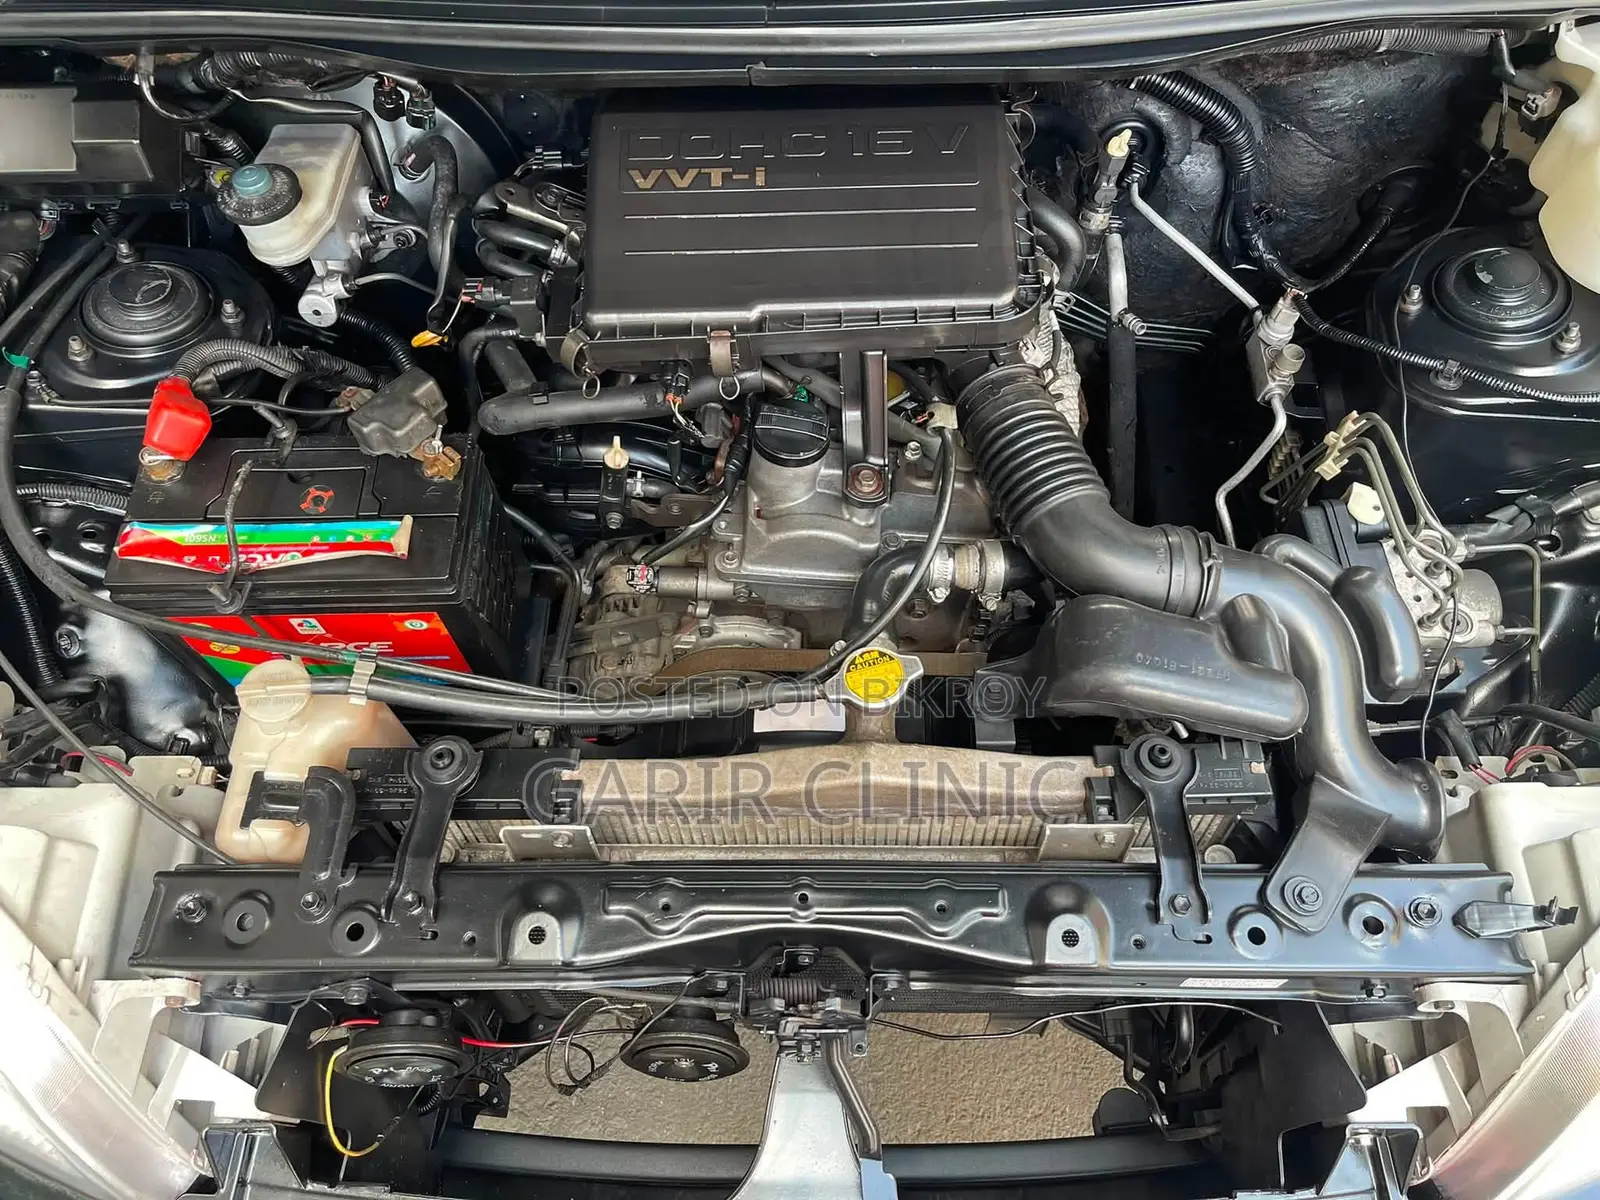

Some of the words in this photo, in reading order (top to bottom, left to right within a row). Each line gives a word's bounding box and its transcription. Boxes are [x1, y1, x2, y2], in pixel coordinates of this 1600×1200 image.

[627, 131, 827, 161] DOHC
[627, 166, 768, 189] VVT-i
[849, 655, 891, 672] CAUTION
